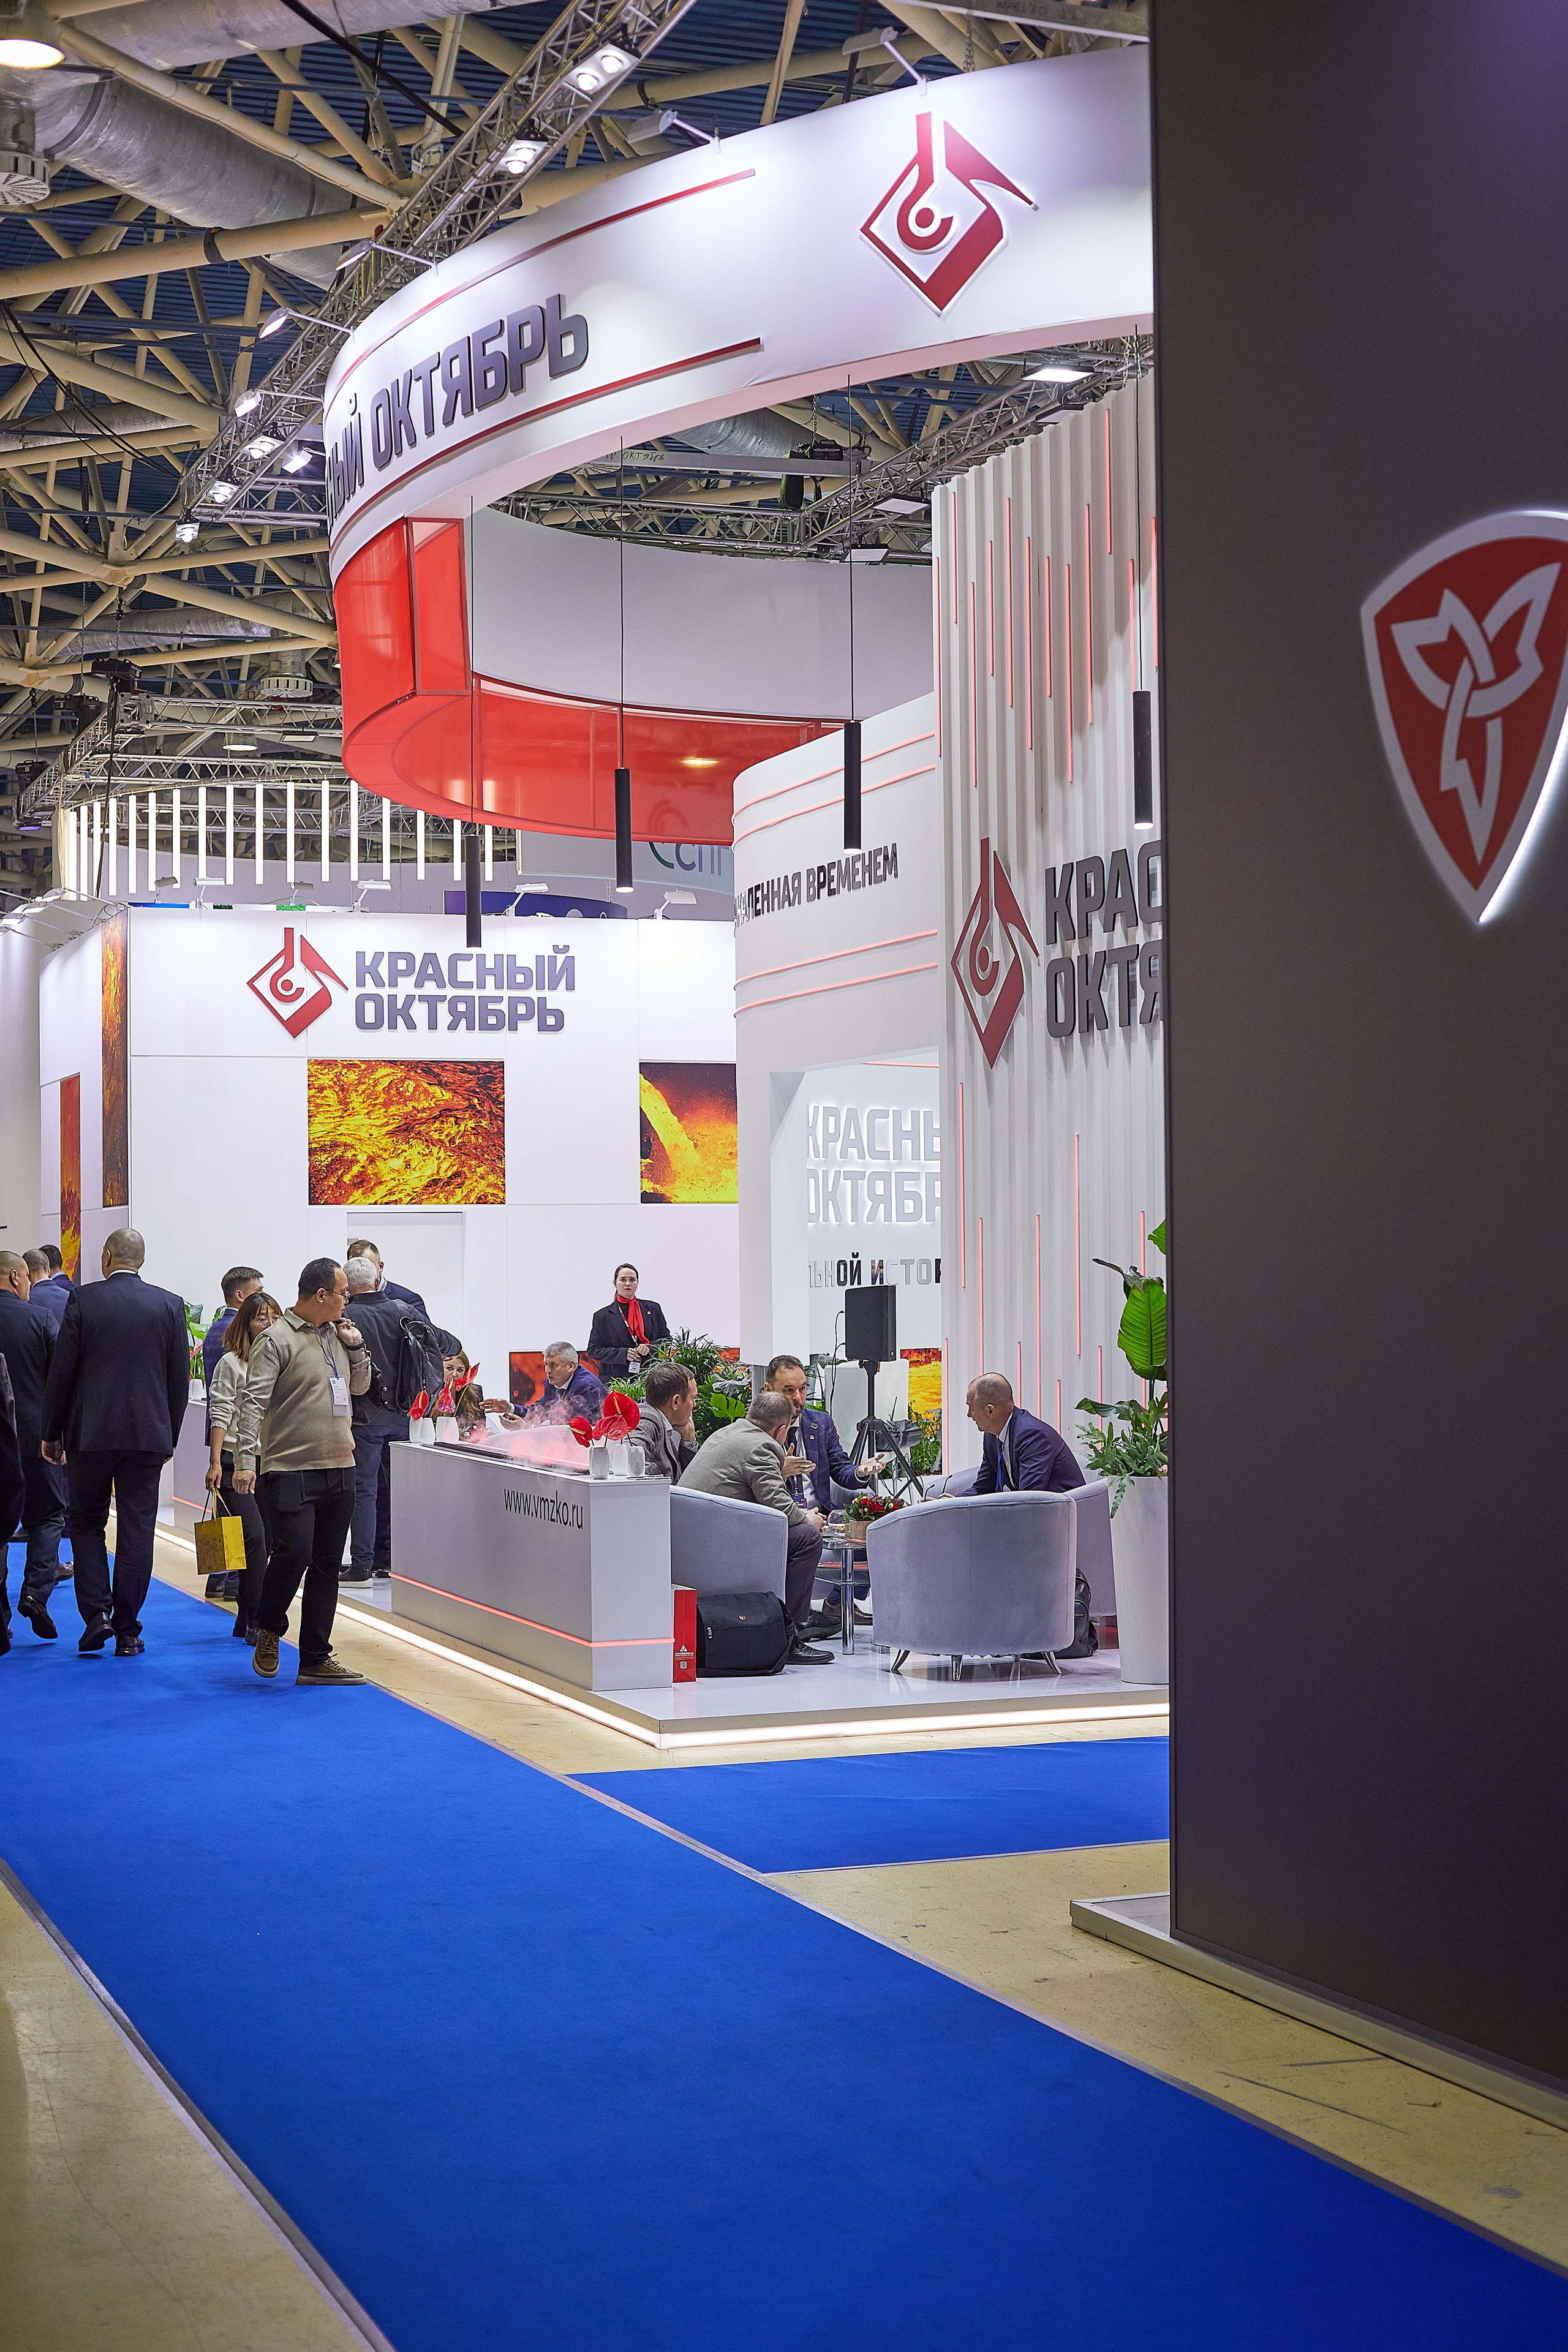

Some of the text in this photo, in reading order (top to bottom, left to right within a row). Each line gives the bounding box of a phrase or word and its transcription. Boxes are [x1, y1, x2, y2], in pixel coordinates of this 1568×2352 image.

[326, 294, 589, 534] НЫЙ ОКТЯБРЬ
[806, 843, 899, 903] ВРЕМЕНЕМ
[355, 944, 576, 991] КРАСНЫЙ
[1046, 939, 1163, 1038] ОКТЯ
[355, 993, 565, 1032] ОКТЯБРЬ
[503, 1488, 583, 1529] www.vmzko.ru
